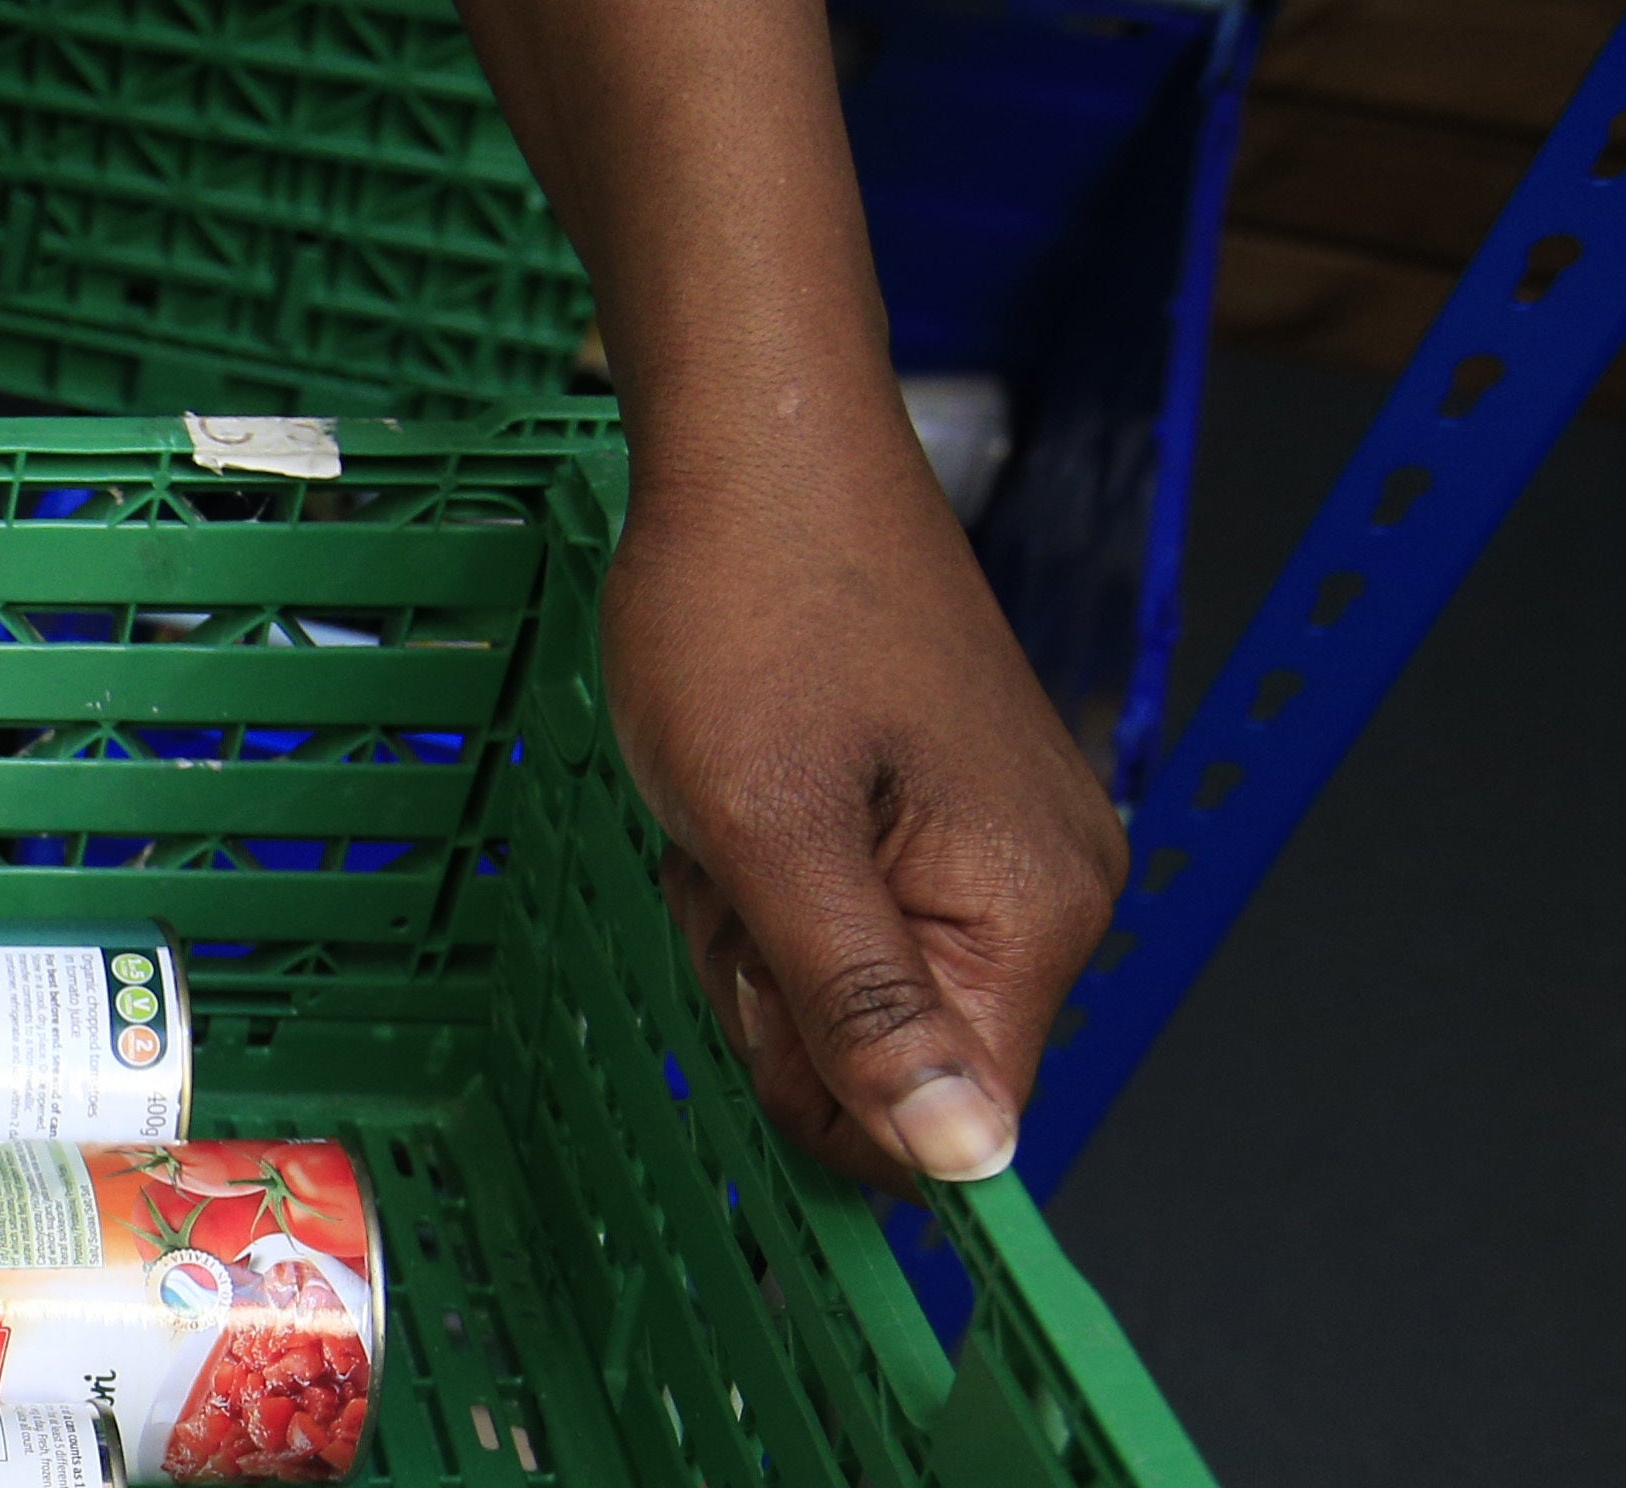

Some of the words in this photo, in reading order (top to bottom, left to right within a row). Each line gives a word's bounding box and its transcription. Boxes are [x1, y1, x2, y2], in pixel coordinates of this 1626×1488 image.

[85, 995, 102, 1050] chopped
[141, 1091, 168, 1137] 400g
[69, 1434, 82, 1465] counts
[55, 1450, 70, 1488] different
[73, 1468, 82, 1480] as
